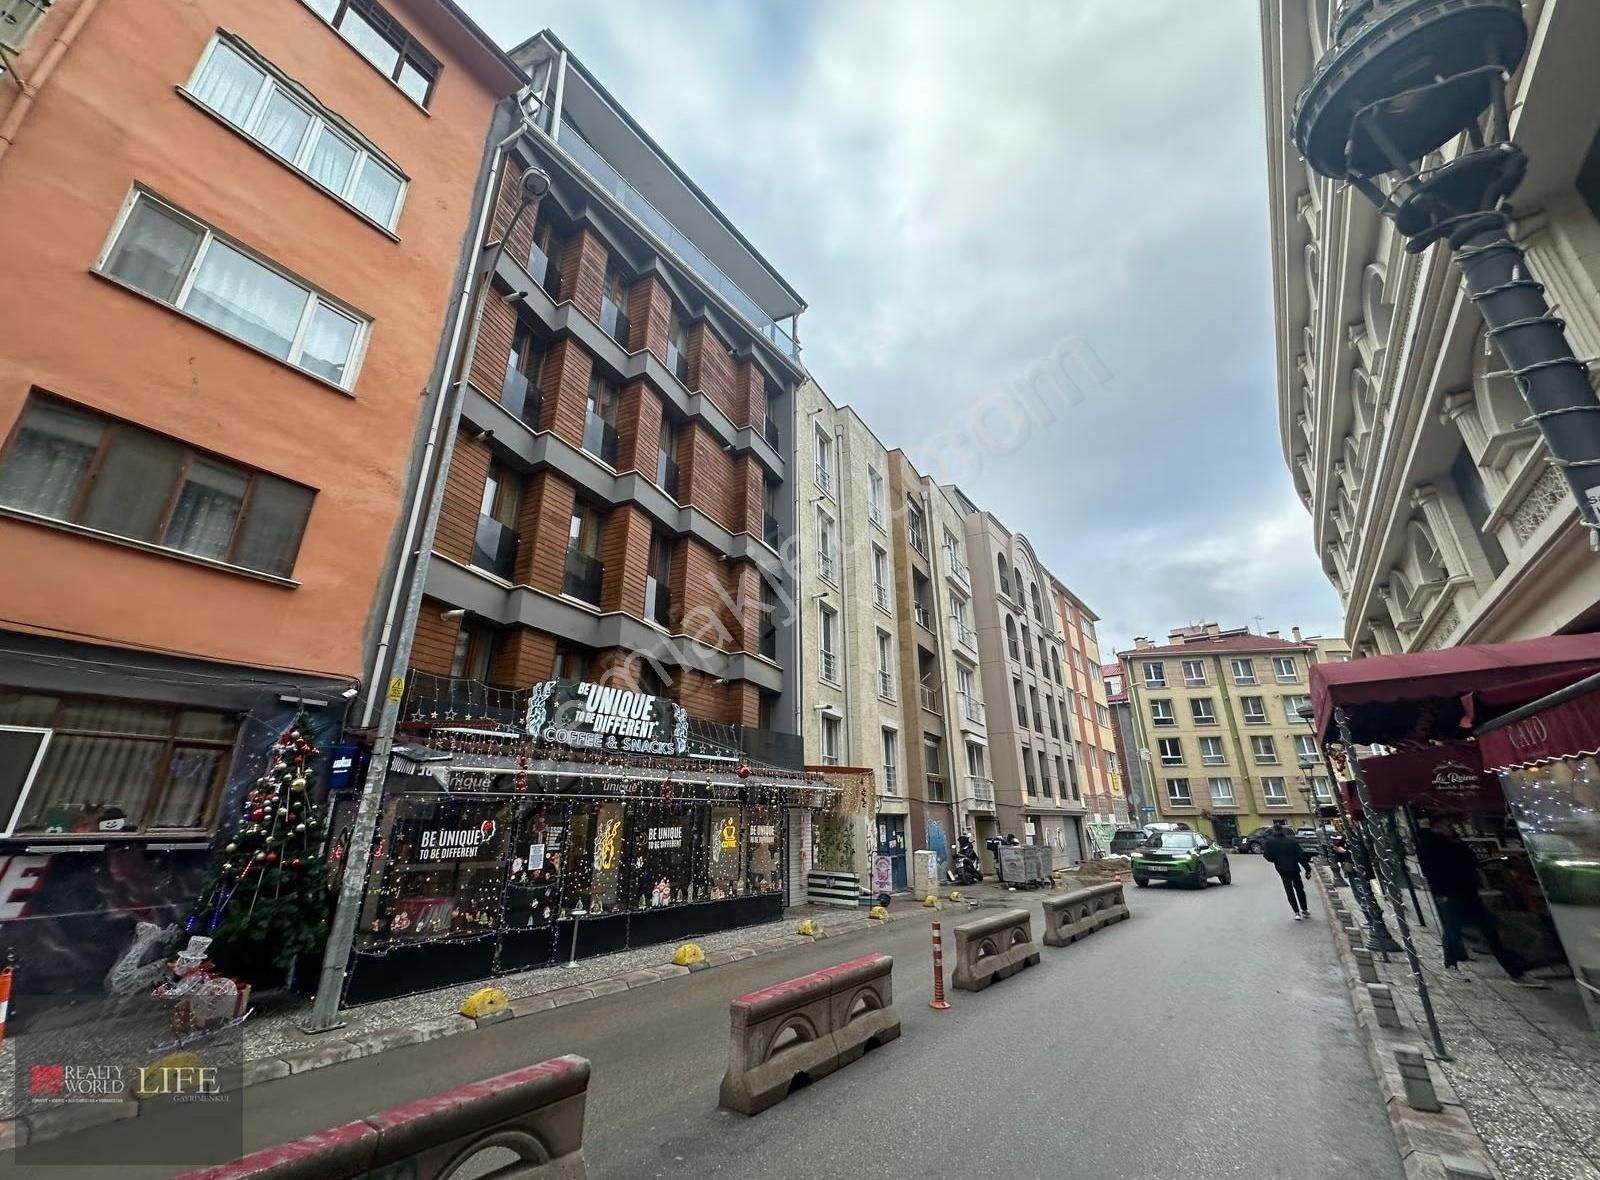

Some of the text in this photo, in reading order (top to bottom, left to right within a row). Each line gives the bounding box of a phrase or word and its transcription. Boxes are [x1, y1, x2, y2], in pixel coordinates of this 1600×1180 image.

[577, 681, 656, 721] BE UNIQUE
[575, 710, 657, 739] TO BE DIFFERENT
[544, 728, 675, 755] COFFEE & SNACKS
[449, 775, 491, 790] nique
[421, 828, 481, 848] BE UNIQUE
[648, 826, 682, 841] BE UNIQUE
[749, 825, 756, 836] BE
[648, 841, 654, 850] TO
[654, 840, 660, 849] BE
[420, 847, 478, 860] TO BE DIFFERENT
